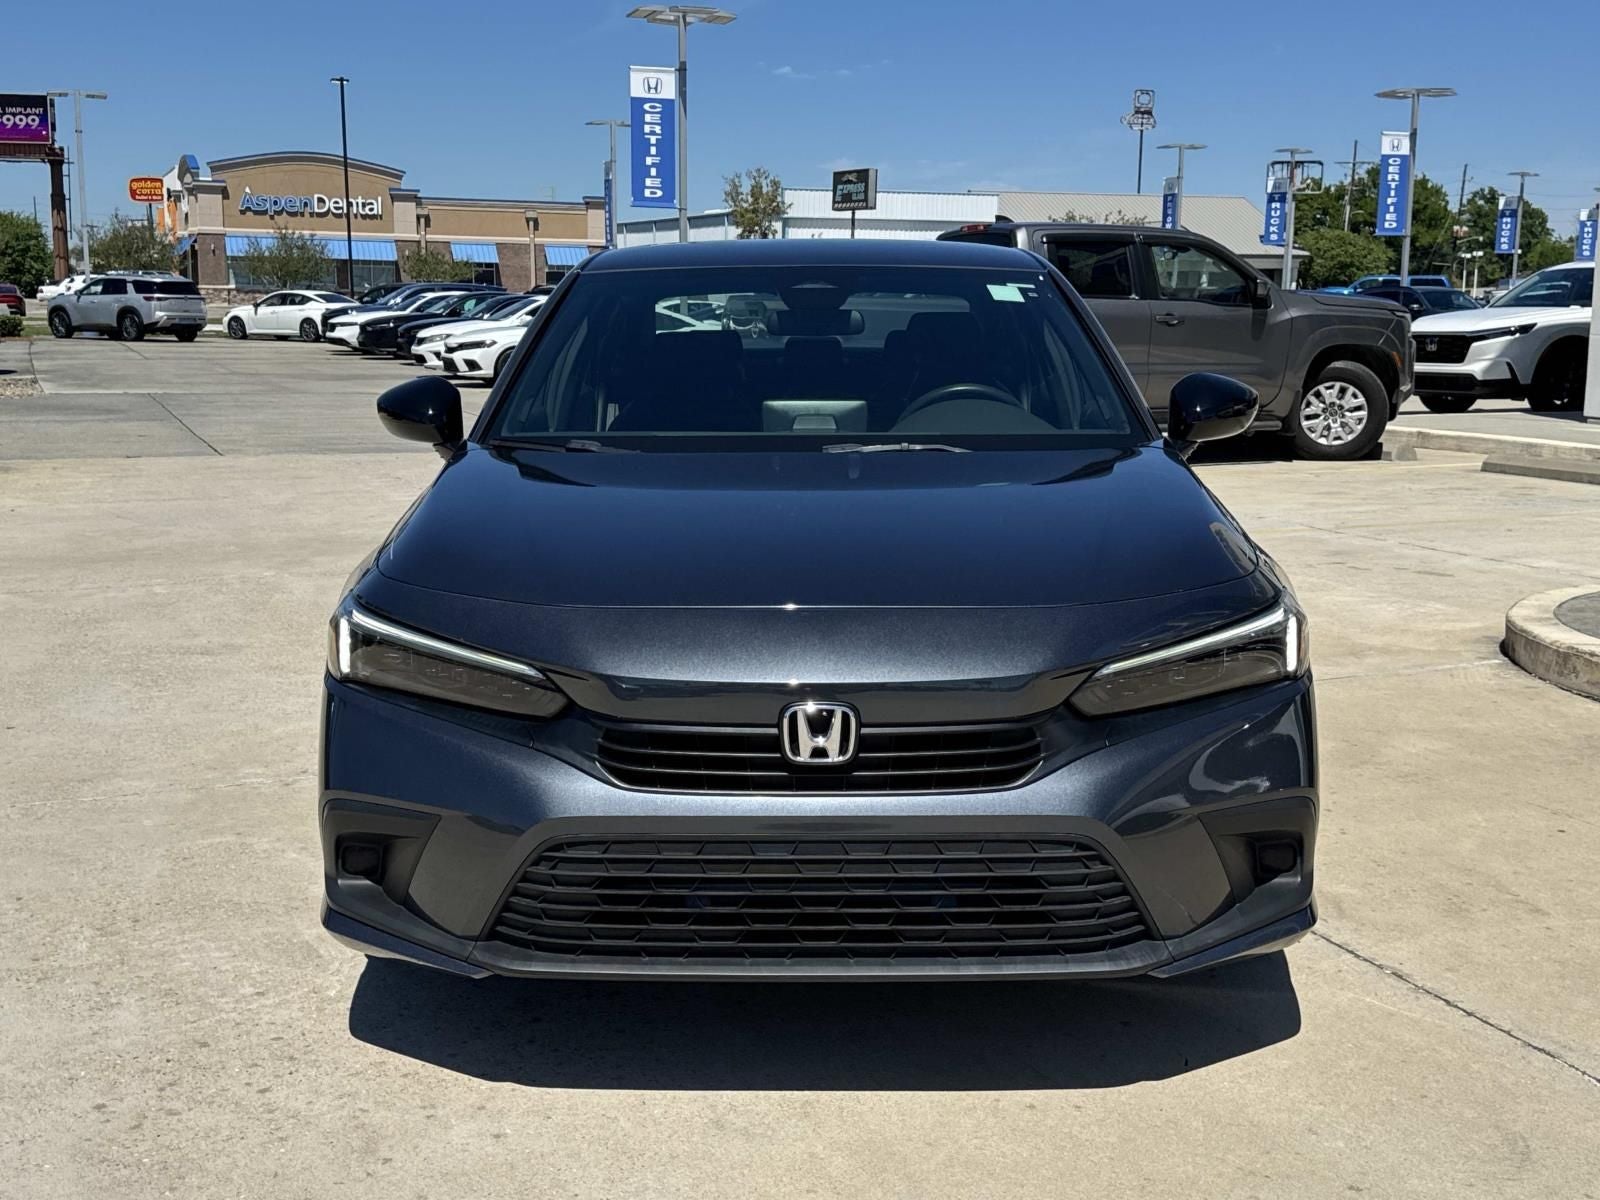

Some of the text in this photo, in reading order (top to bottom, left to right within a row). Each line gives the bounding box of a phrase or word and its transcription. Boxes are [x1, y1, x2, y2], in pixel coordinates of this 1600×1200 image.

[0, 114, 40, 129] 999
[5, 106, 44, 115] IMPLANT
[643, 102, 663, 198] CERTIFIED
[1384, 157, 1401, 229] CERTIFIED
[1269, 194, 1281, 241] TRUCKS
[1500, 210, 1511, 250] TRUCKS
